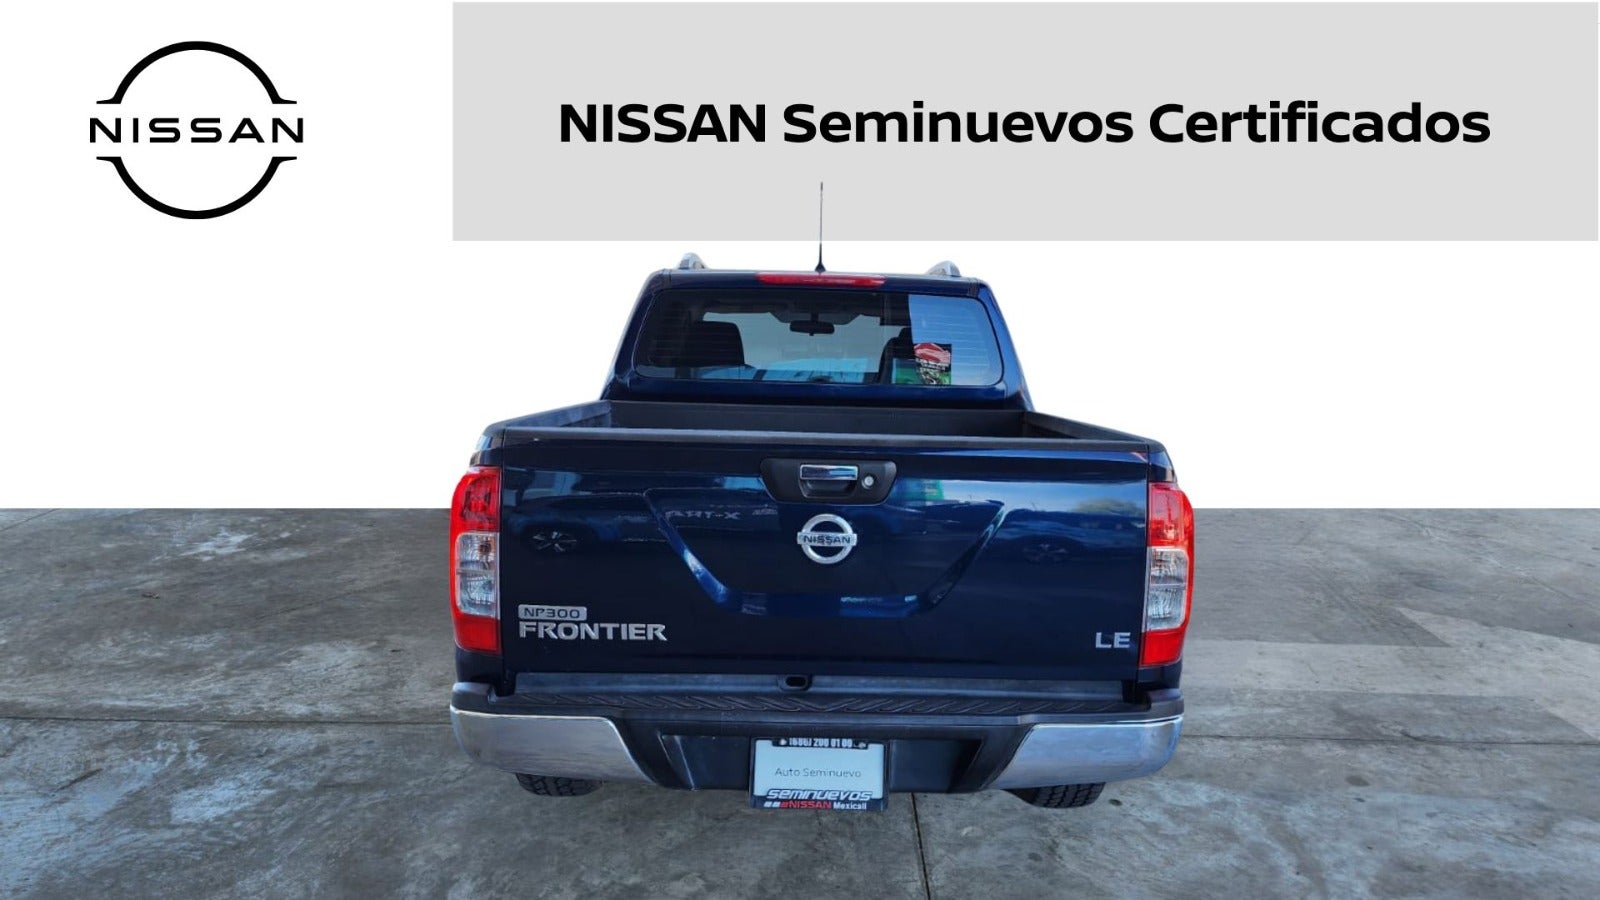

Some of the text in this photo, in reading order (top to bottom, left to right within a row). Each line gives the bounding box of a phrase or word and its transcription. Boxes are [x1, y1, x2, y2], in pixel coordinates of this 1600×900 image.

[803, 533, 850, 545] NISSAN
[523, 607, 580, 619] NP300
[518, 621, 667, 641] FRONTIER
[1095, 632, 1131, 648] LE
[774, 767, 862, 778] Auto Seminuevo
[766, 789, 872, 801] seminuevos
[788, 801, 867, 810] NISSAN Mexicali
